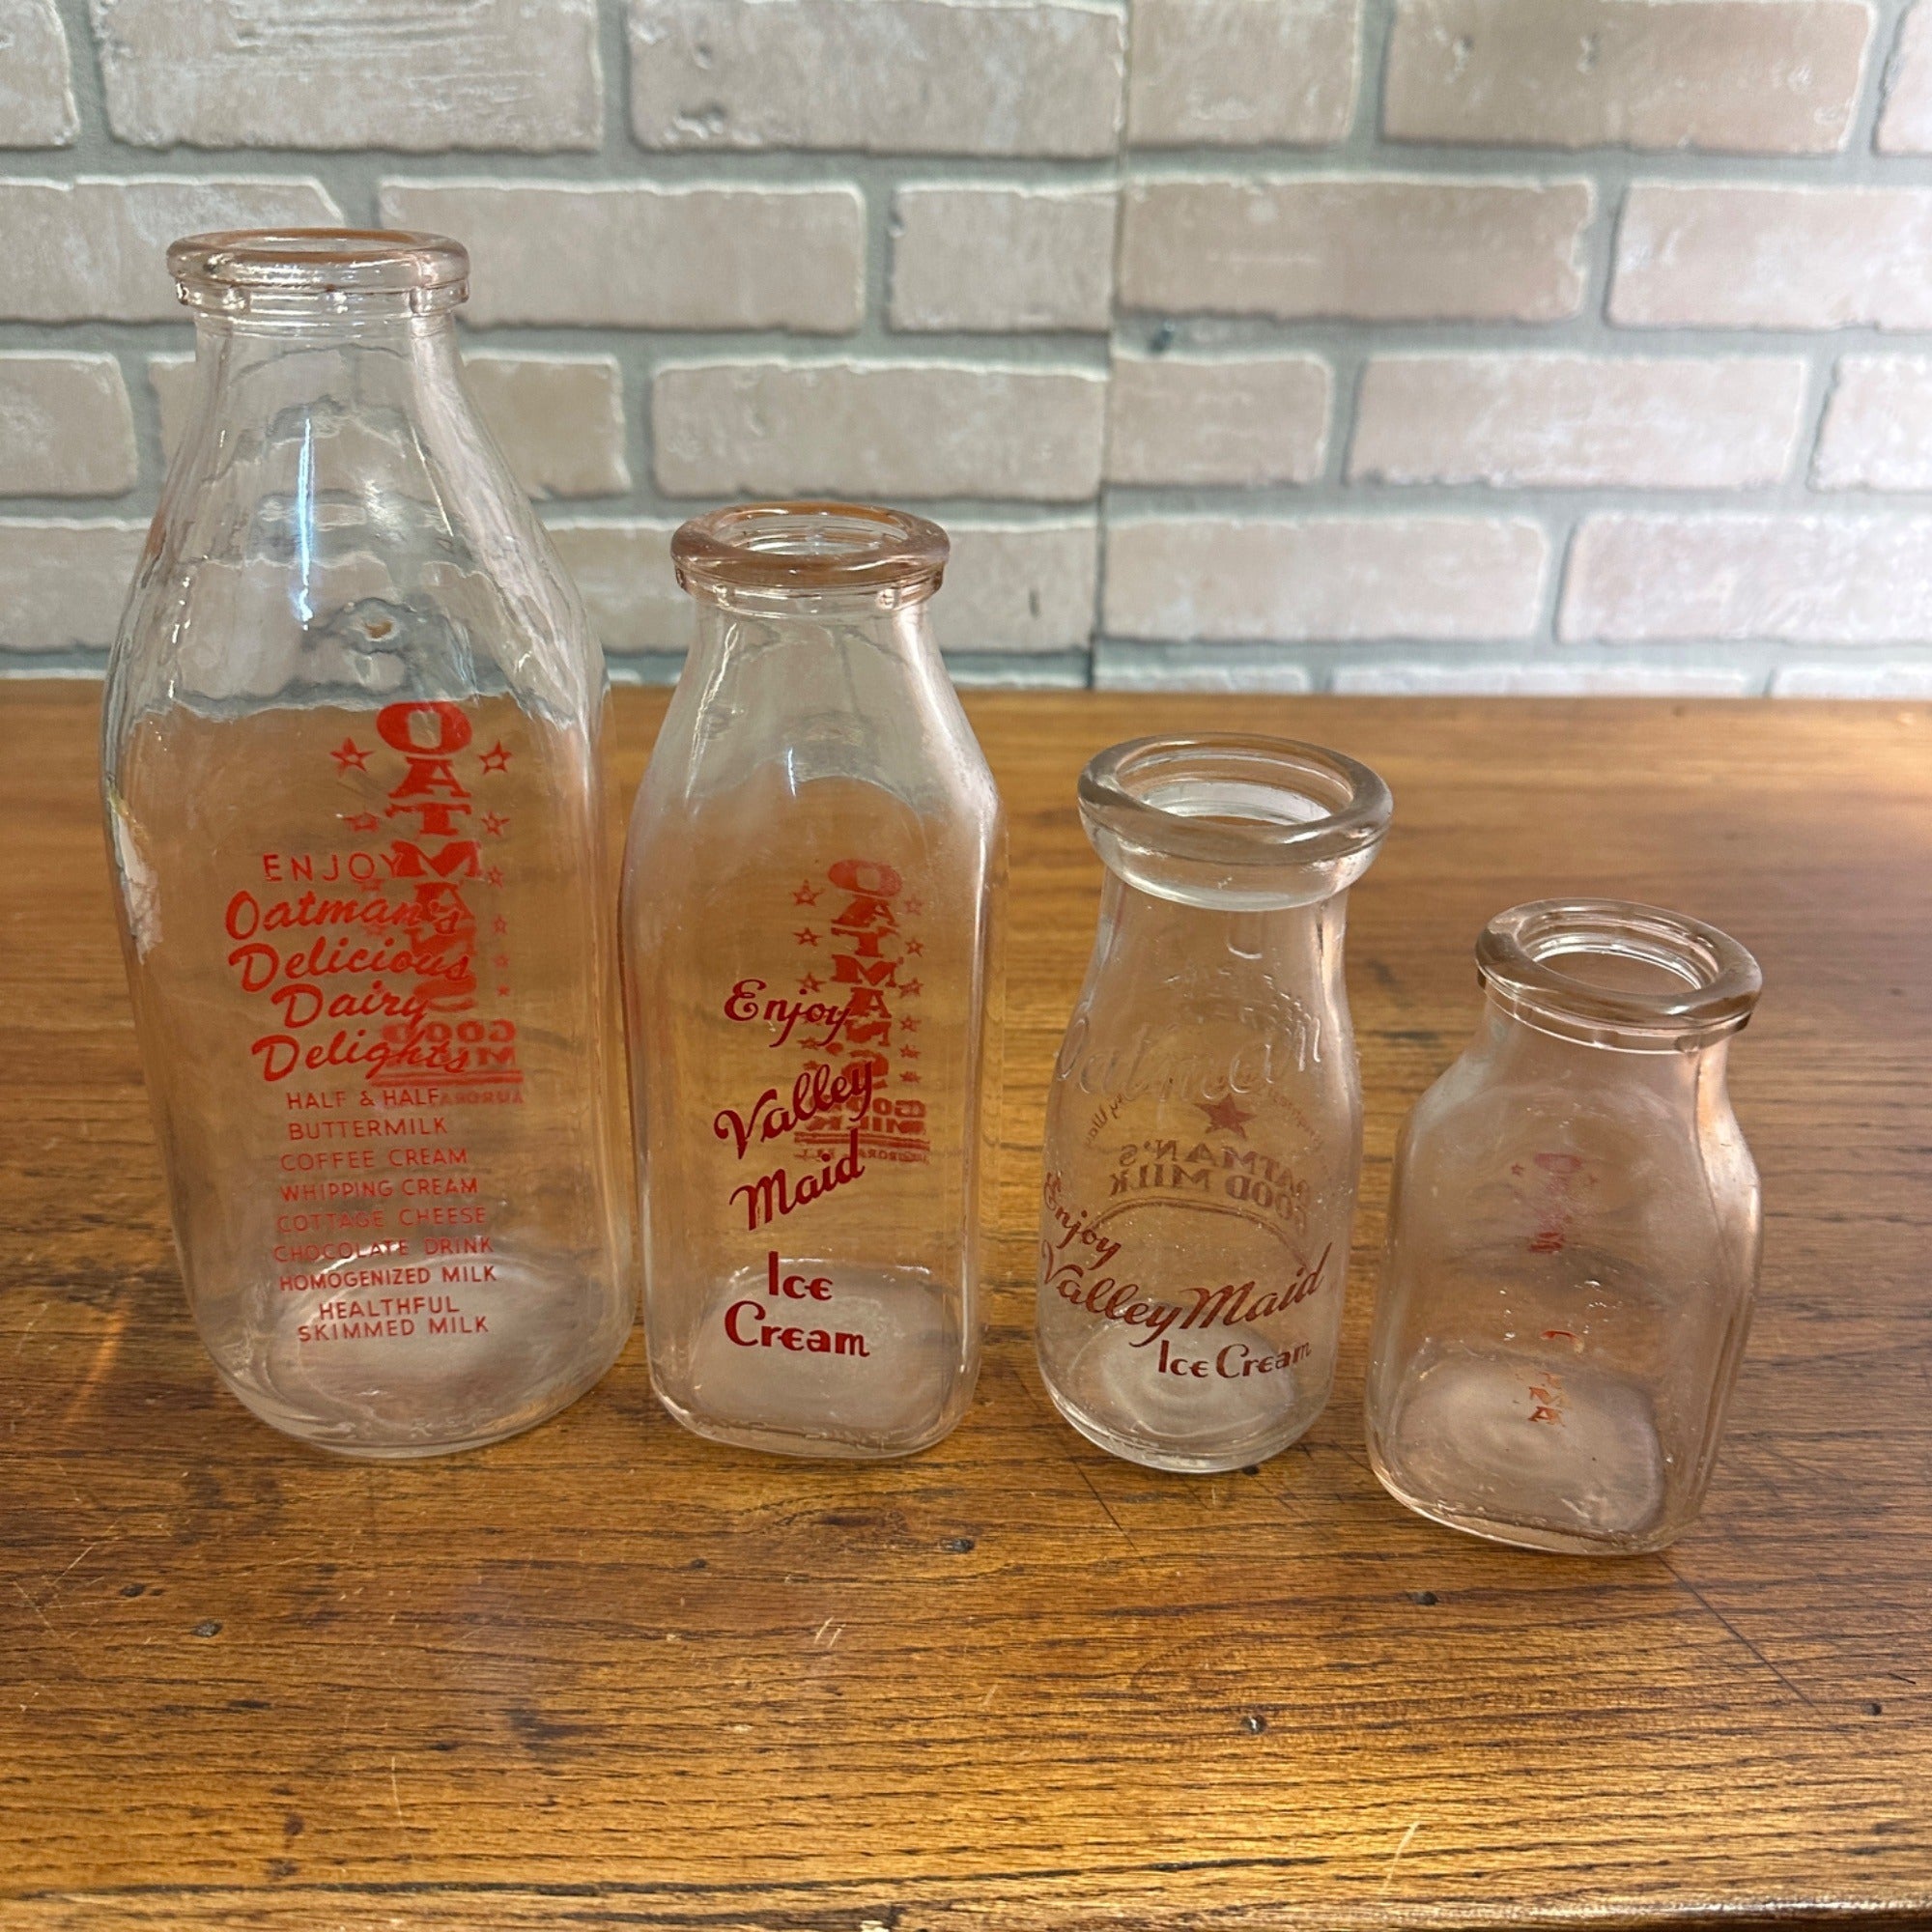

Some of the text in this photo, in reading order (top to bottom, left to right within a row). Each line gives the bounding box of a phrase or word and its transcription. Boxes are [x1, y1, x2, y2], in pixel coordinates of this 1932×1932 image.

[263, 852, 406, 882] ENJOY
[225, 890, 461, 940] Oatman's
[228, 935, 470, 992] Delicious
[270, 980, 428, 1030] Dairy
[724, 979, 852, 1048] Enjoy
[251, 1029, 469, 1082] Delights
[287, 1089, 440, 1110] HALF & HALF
[713, 1061, 872, 1160] Valley
[288, 1116, 448, 1141] BUTTERMILK
[280, 1148, 469, 1172] COFFEE CREAM
[729, 1127, 867, 1232] Maid
[280, 1177, 479, 1203] WHIPPING CREAM
[277, 1207, 487, 1235] COTTAGE CHEESE
[1043, 1171, 1122, 1270] Enjoy
[272, 1236, 495, 1264] CHOCOLATE DRINK
[279, 1264, 497, 1292] HOMOGENIZED MILK
[768, 1250, 834, 1301] Ice
[1041, 1239, 1333, 1348] Valley Maid
[298, 1315, 490, 1343] SKIMMED MILK
[319, 1295, 461, 1321] HEALTHFUL
[724, 1300, 870, 1358] Cream
[1158, 1340, 1312, 1379] Ice Cream
